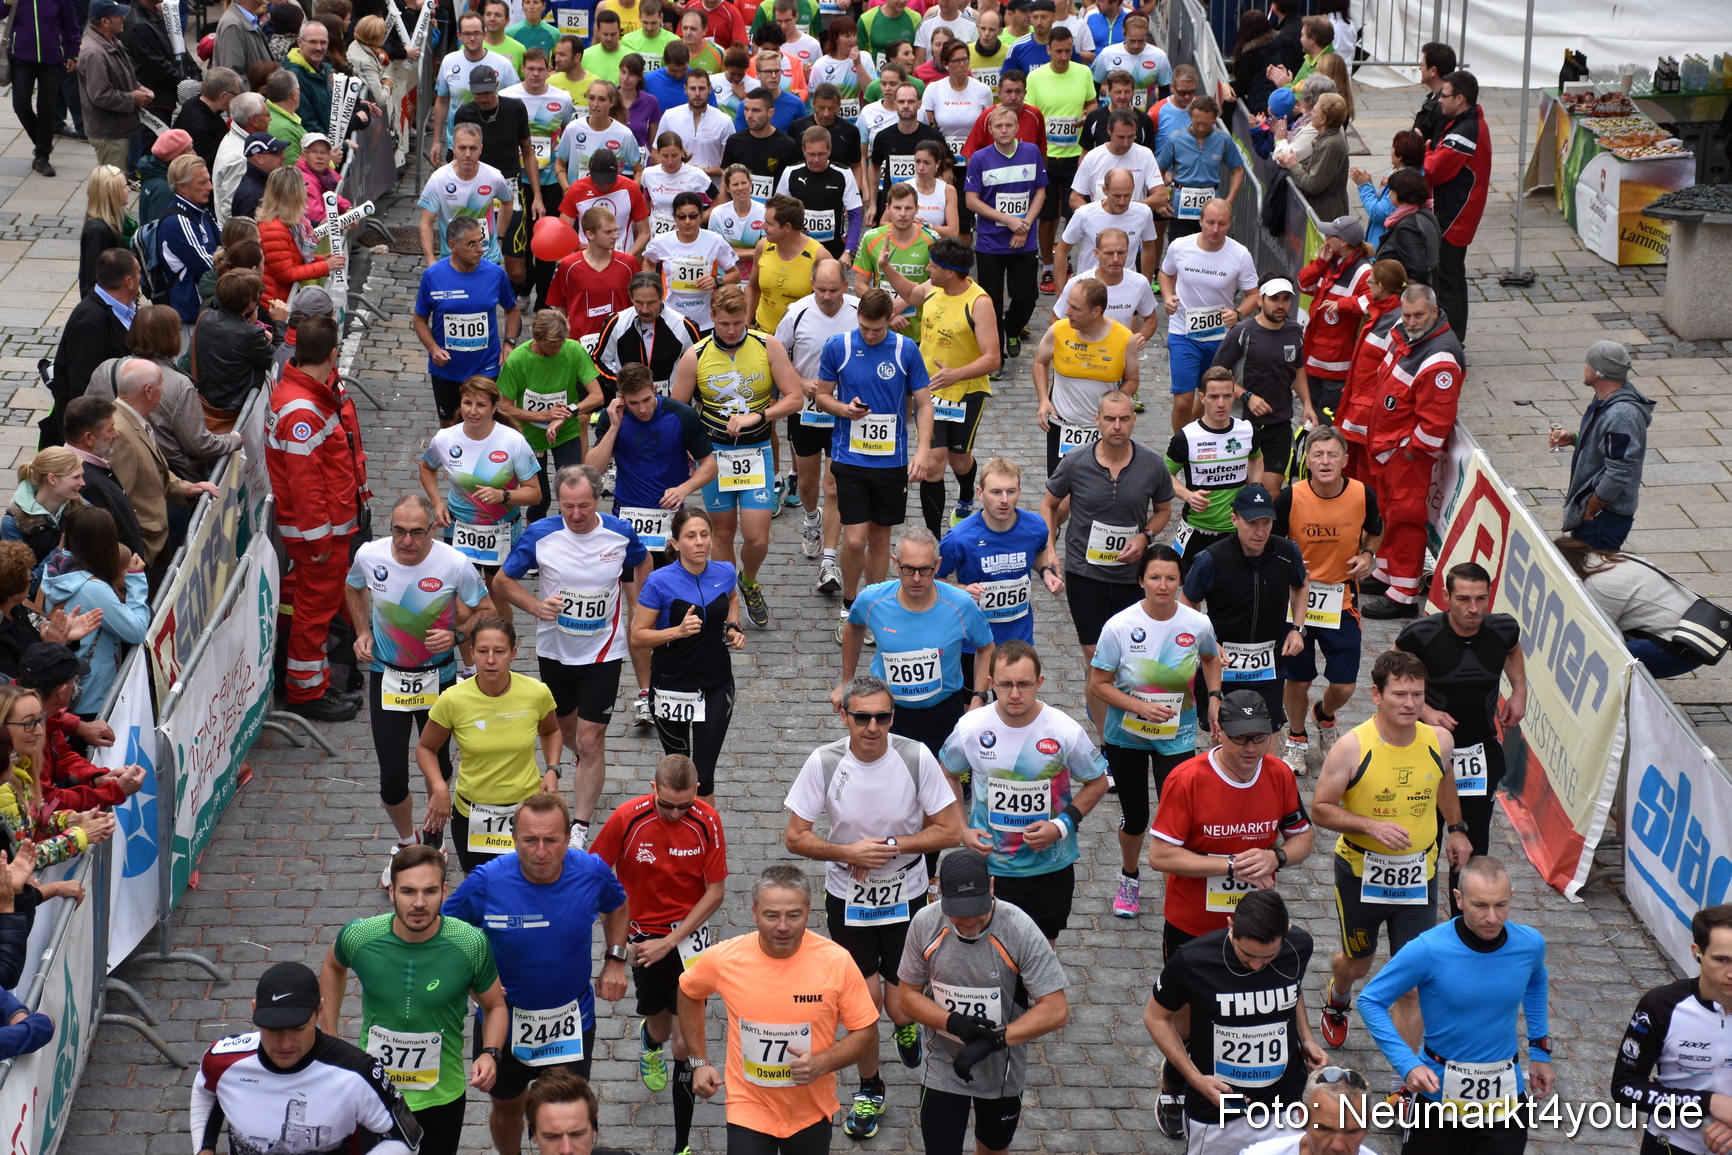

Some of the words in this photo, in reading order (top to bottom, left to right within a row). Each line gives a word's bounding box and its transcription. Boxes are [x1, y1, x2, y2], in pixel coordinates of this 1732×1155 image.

[567, 16, 580, 27] 82
[332, 81, 343, 122] Laufsport
[343, 96, 355, 121] BMW
[1050, 123, 1077, 135] 2780
[1000, 201, 1027, 214] 2064
[328, 212, 340, 237] BMW
[340, 211, 361, 228] BMW
[803, 218, 832, 230] 2063
[679, 268, 704, 281] 316
[1184, 266, 1227, 278] www.hasit.de
[1191, 313, 1223, 331] 2508
[449, 322, 485, 337] 3109
[861, 424, 888, 440] 136
[1065, 429, 1100, 444] 2678
[733, 459, 751, 475] 93
[1196, 463, 1246, 475] Laufteam
[1207, 473, 1237, 483] Fürth
[1307, 527, 1340, 538] OEXL
[457, 531, 497, 549] 3080
[1105, 536, 1127, 551] 90
[981, 552, 1027, 567] HUBER
[560, 590, 577, 598] PARTL
[985, 588, 1028, 609] 2056
[563, 598, 606, 619] 2150
[993, 608, 1019, 618] Thomas
[566, 619, 600, 630] Leonhard
[1242, 643, 1268, 651] Neumarkt
[1228, 651, 1271, 669] 2750
[890, 662, 935, 684] 2697
[1235, 672, 1263, 681] Michael
[400, 679, 423, 694] 56
[901, 685, 929, 695] Markus
[394, 697, 425, 705] Gerhard
[661, 702, 695, 721] 340
[1140, 725, 1160, 734] Anita
[990, 783, 1009, 791] PARTL
[995, 792, 1046, 812] 2493
[1003, 816, 1035, 826] Damian
[1203, 821, 1270, 836] NEUMARKT
[669, 847, 700, 857] Marcel
[1366, 857, 1386, 865] PARTL
[869, 877, 898, 885] Neumarkt
[1369, 866, 1422, 886] 2682
[853, 883, 902, 906] 2427
[1383, 889, 1407, 898] Klaus
[859, 906, 896, 919] Reinhard
[793, 994, 823, 1003] THULE
[932, 985, 952, 997] PARTL
[953, 991, 988, 1000] Neumarkt
[1215, 983, 1299, 1017] THULE
[514, 1011, 536, 1022] PARTL
[538, 1010, 569, 1022] Neumarkt
[371, 1028, 392, 1043] PARTL
[393, 1037, 430, 1045] Neumarkt
[519, 1016, 576, 1046] 2448
[740, 1025, 762, 1036] PARTL
[763, 1029, 799, 1037] Neumarkt
[1216, 1028, 1241, 1039] PARTL
[1242, 1030, 1276, 1039] Neumarkt
[380, 1044, 428, 1069] 377
[531, 1044, 564, 1059] Werner
[758, 1039, 789, 1063] 77
[1221, 1039, 1282, 1064] 2219
[756, 1067, 791, 1079] Oswald
[1230, 1068, 1271, 1079] Joachim
[1447, 1065, 1472, 1076] PARTL
[1474, 1068, 1506, 1076] Neumarkt
[1460, 1076, 1501, 1099] 281
